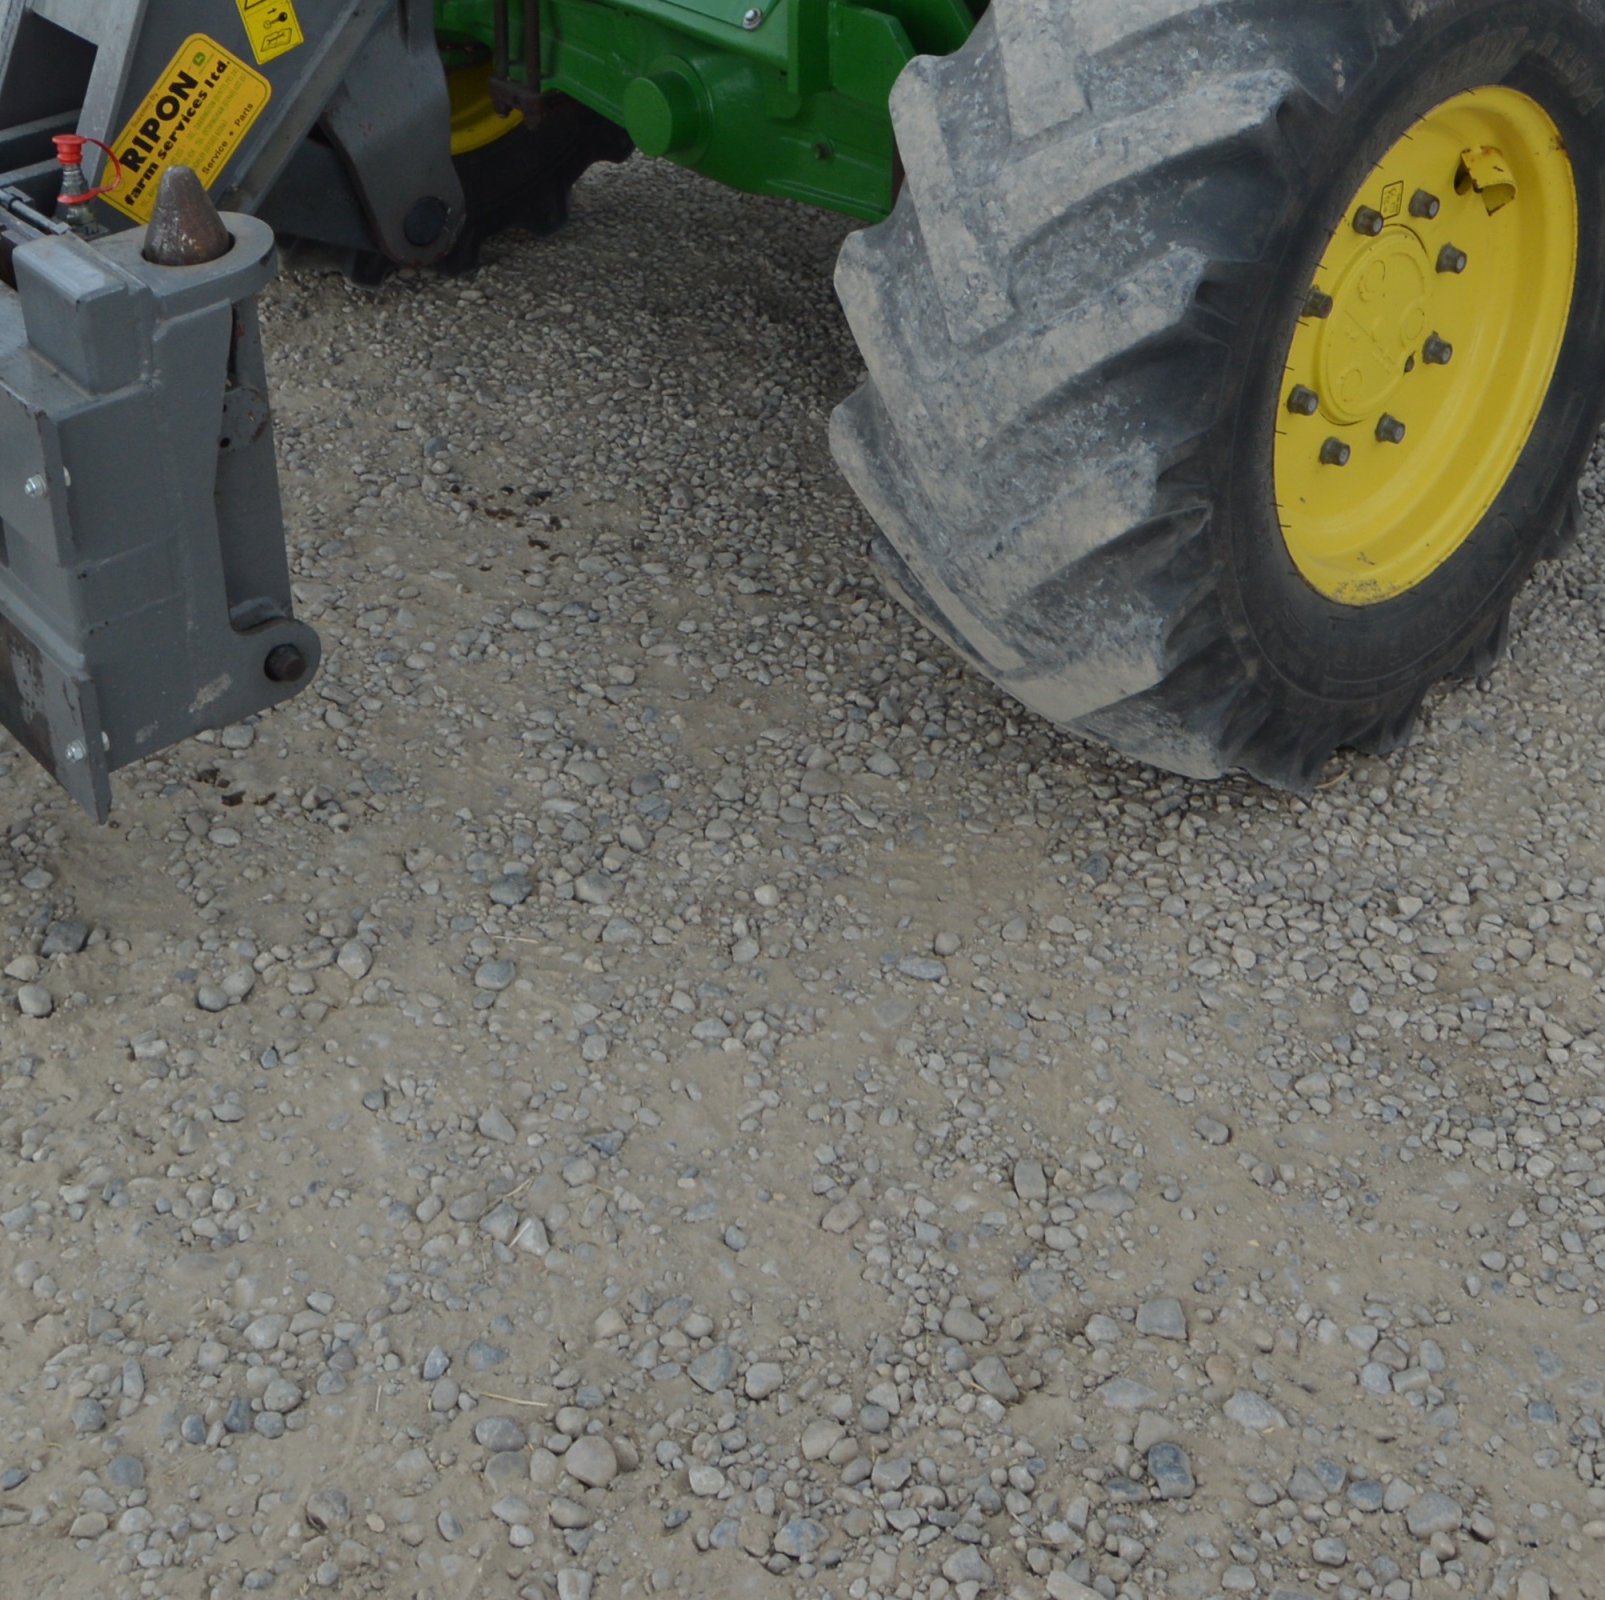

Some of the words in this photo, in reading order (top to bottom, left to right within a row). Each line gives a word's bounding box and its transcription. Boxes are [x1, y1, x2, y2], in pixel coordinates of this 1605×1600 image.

[118, 69, 199, 174] RIPON
[124, 161, 159, 206] farm
[157, 89, 208, 160] services
[204, 59, 231, 87] ltd.
[201, 139, 229, 175] Service
[234, 102, 254, 127] Parts
